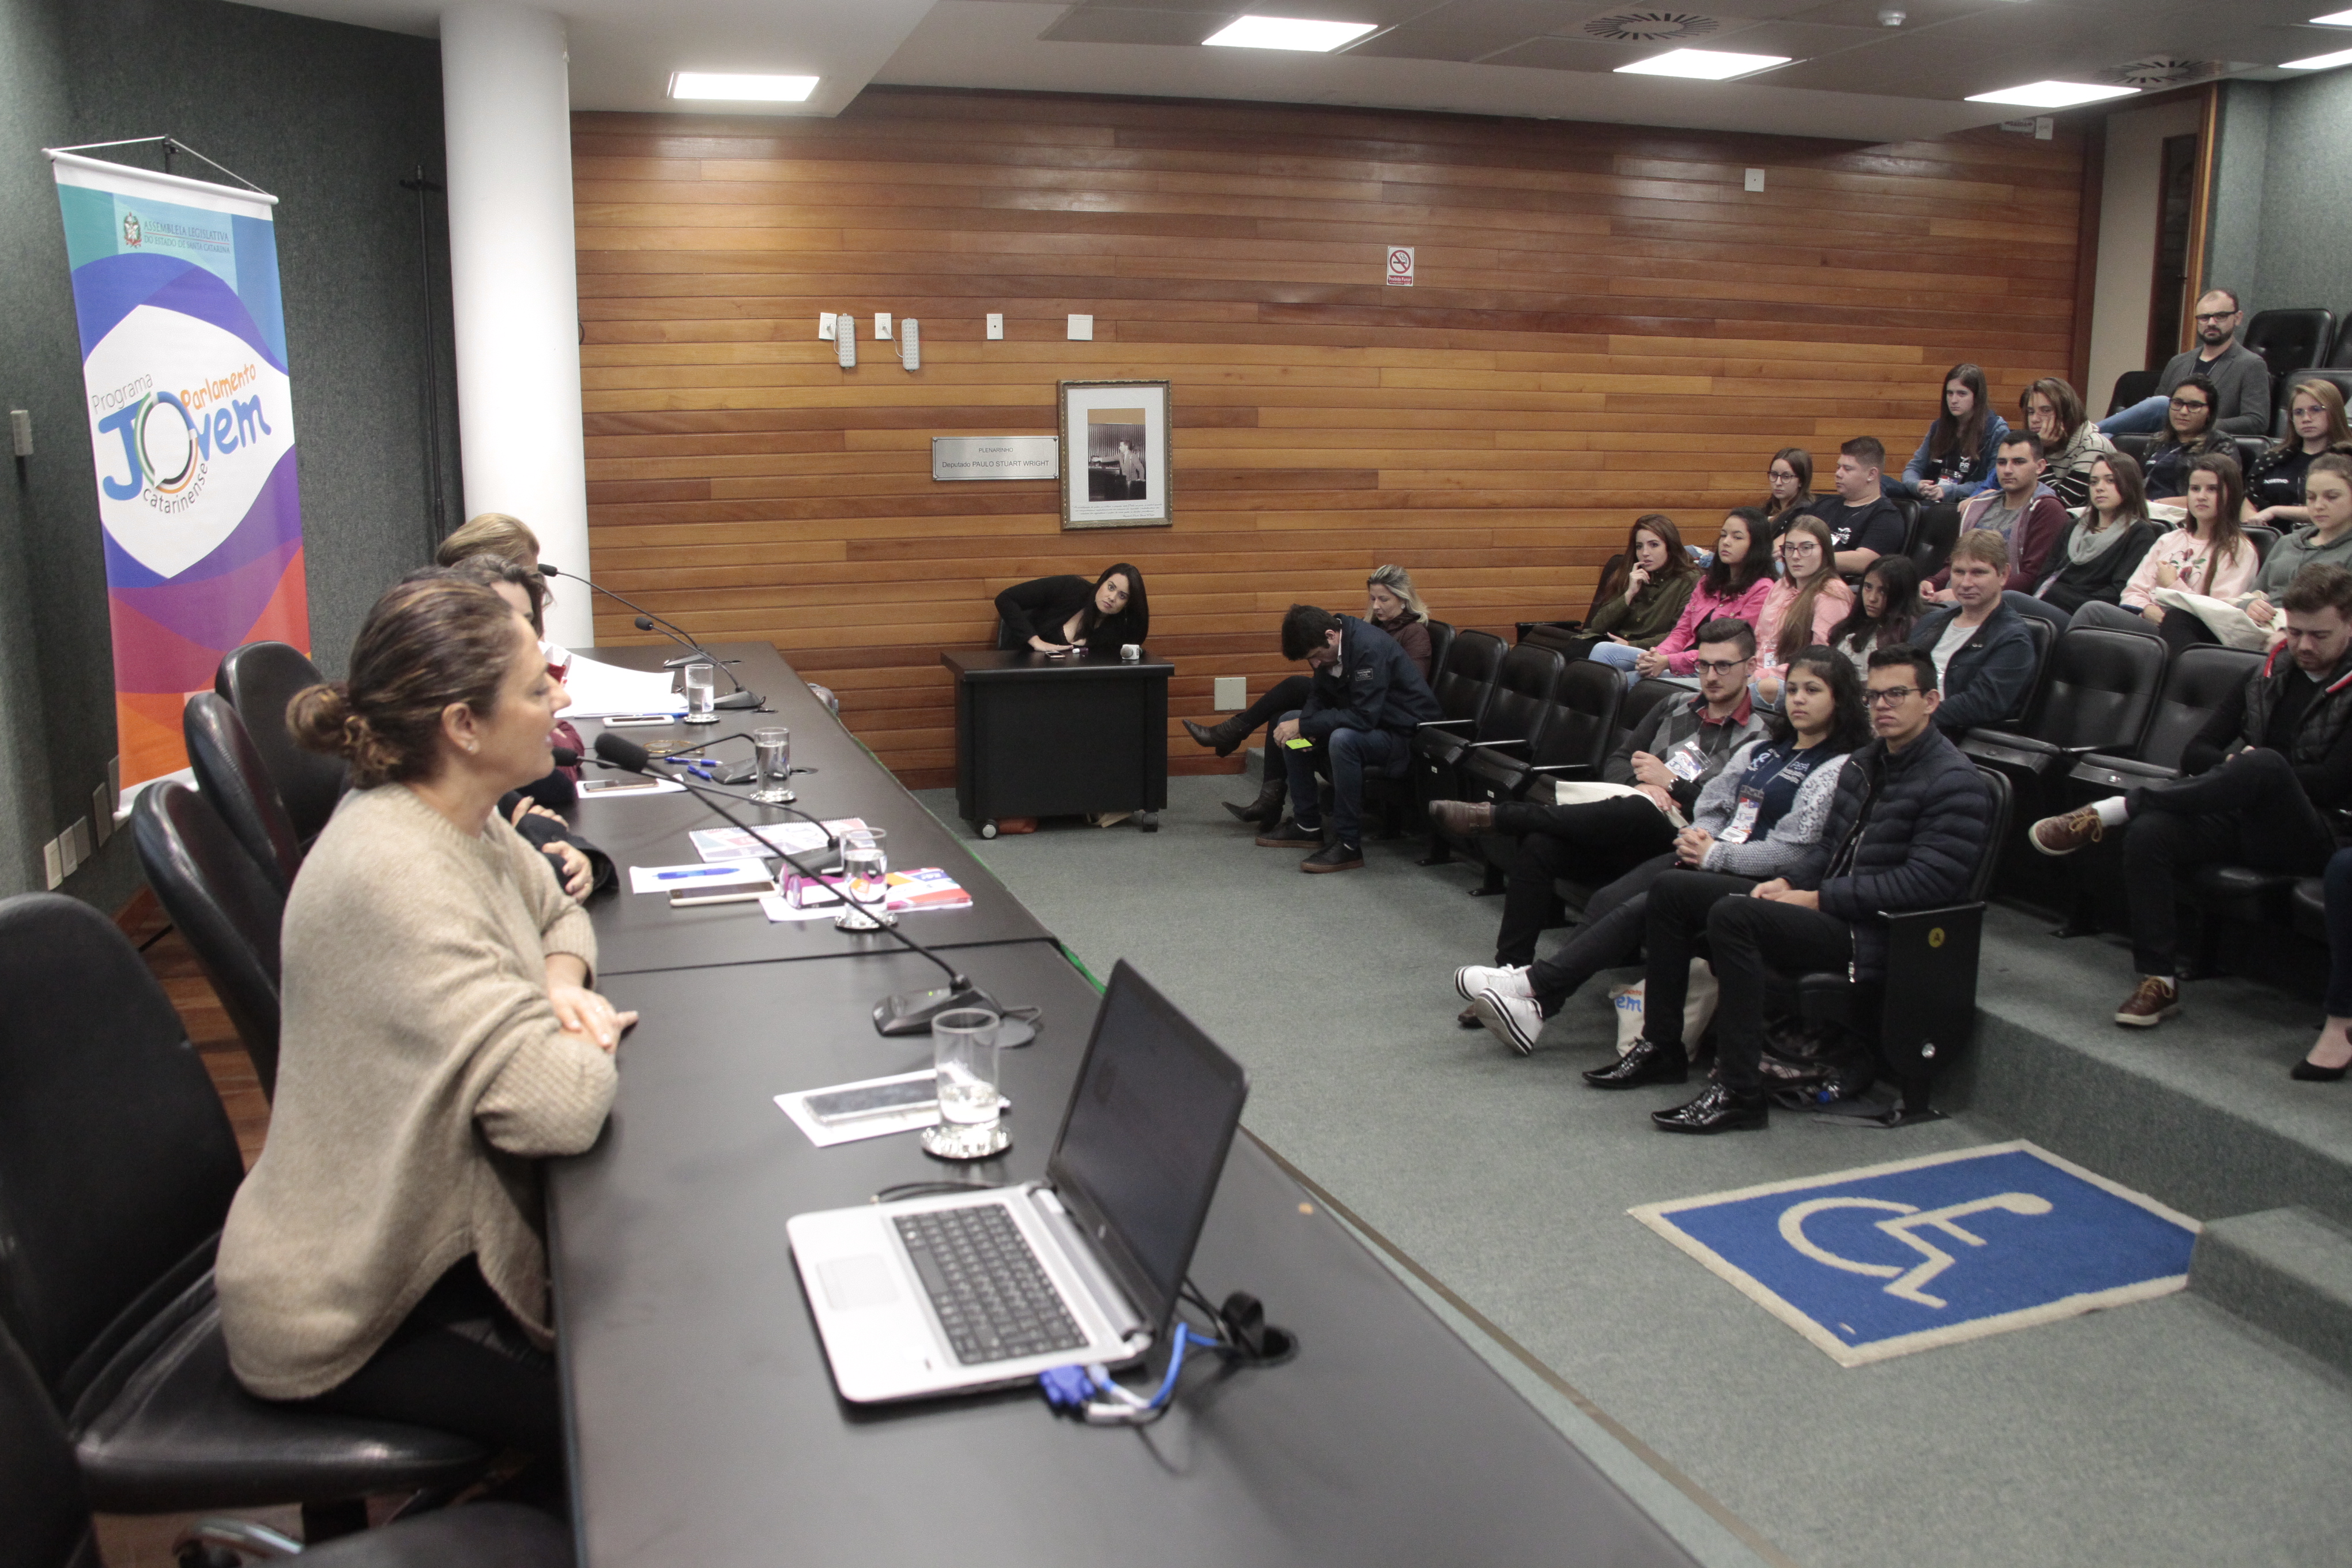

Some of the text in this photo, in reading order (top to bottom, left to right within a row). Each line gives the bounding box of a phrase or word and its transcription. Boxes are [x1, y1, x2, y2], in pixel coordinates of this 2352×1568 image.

[144, 221, 229, 242] ASSEMBLEIA LEGISLATIVA
[145, 235, 230, 254] DO ESTADO DE SANTA CATARINA
[92, 374, 153, 414] Programa
[180, 364, 256, 410] Parlamento
